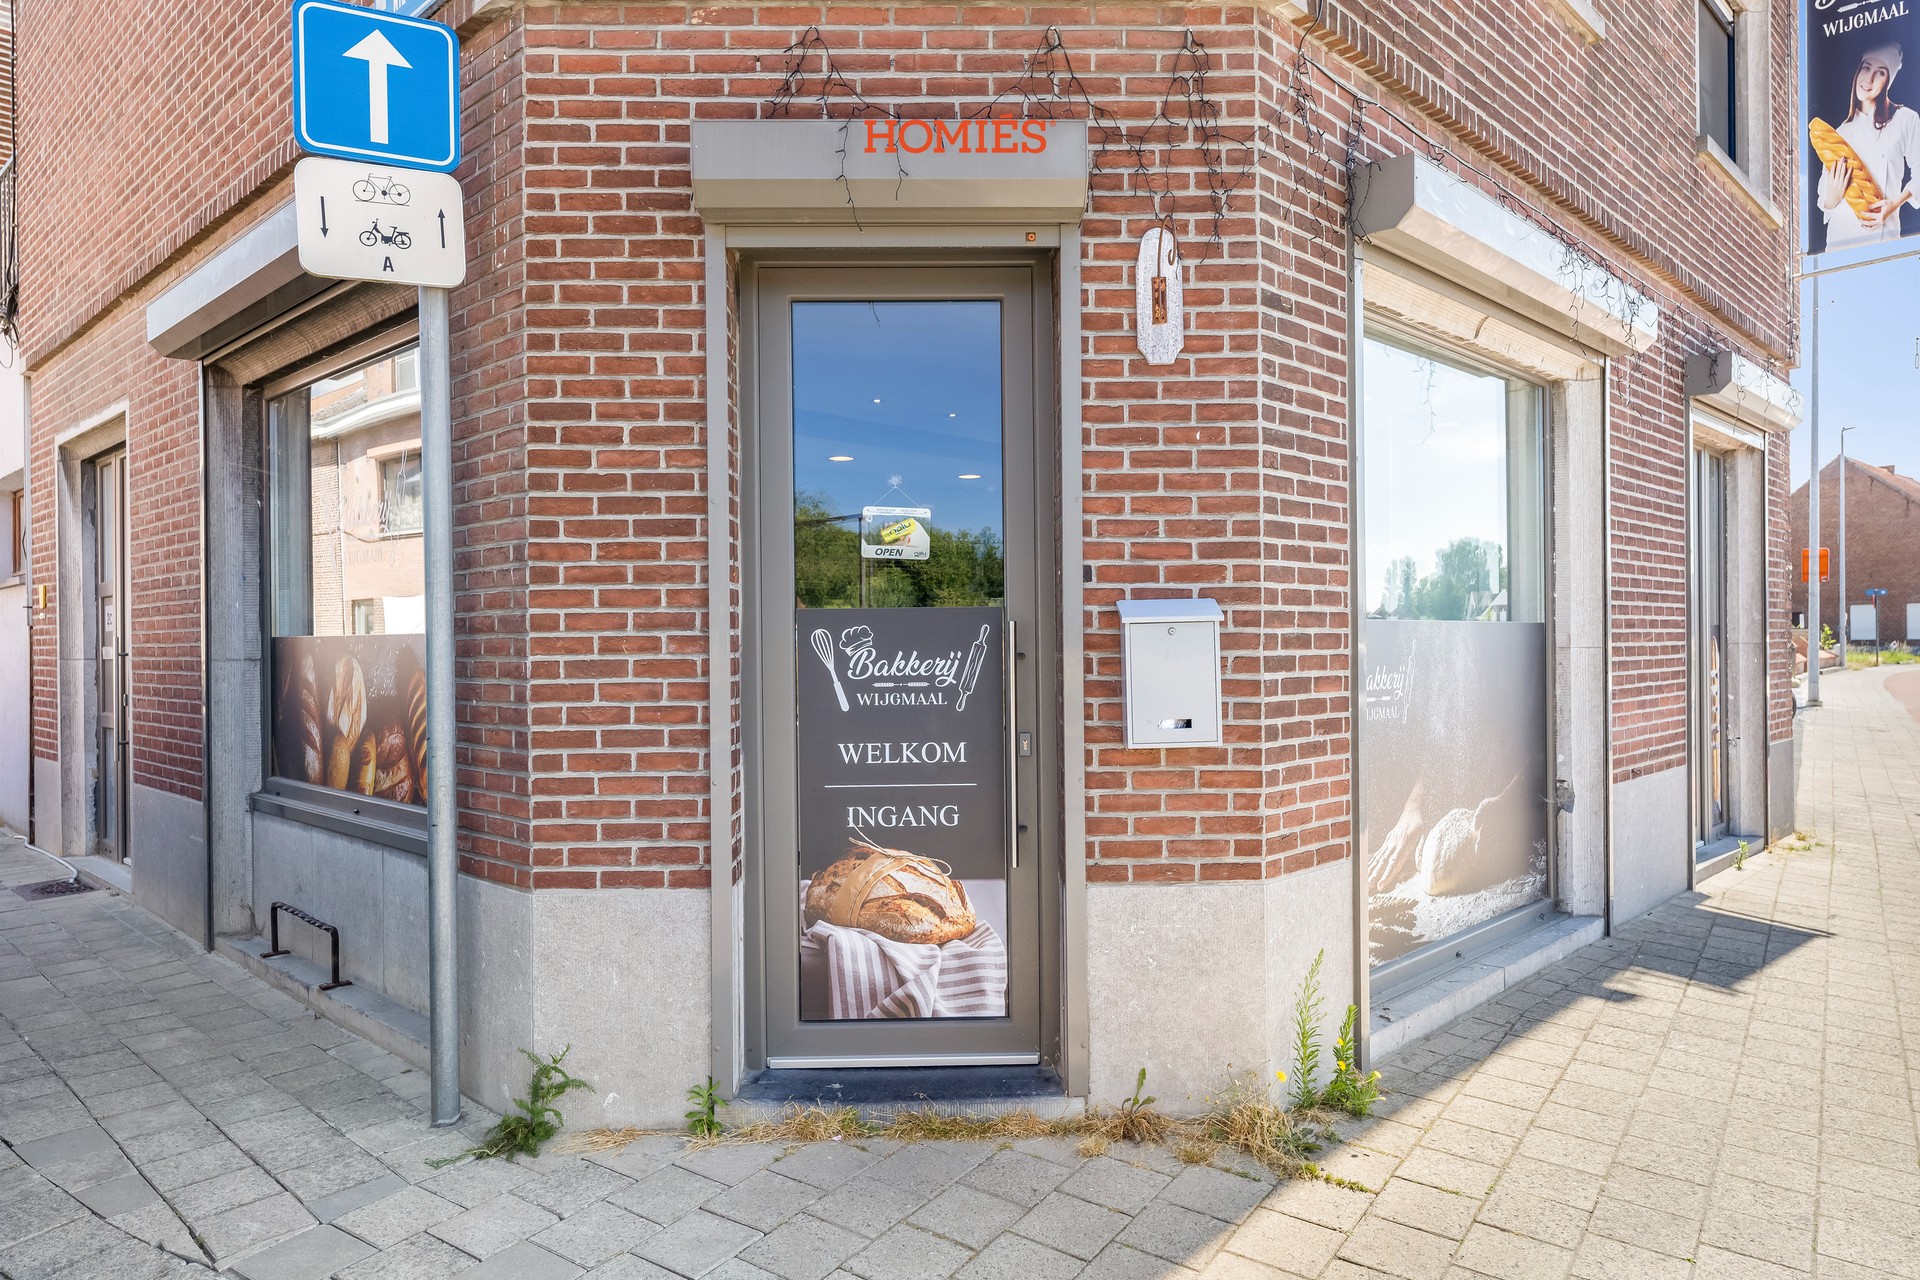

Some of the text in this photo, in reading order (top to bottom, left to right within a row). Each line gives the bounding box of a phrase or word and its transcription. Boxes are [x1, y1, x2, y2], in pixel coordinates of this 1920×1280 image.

[1822, 1, 1909, 37] WIJGMAAL
[382, 256, 394, 272] A
[874, 547, 904, 557] OPEN
[847, 647, 962, 687] Bakkerij
[1365, 665, 1405, 701] akkerij
[856, 692, 948, 706] WIJGMAAL
[1366, 706, 1400, 720] IJGMAAL
[838, 742, 967, 764] WELKOM
[846, 805, 960, 828] INGANG
